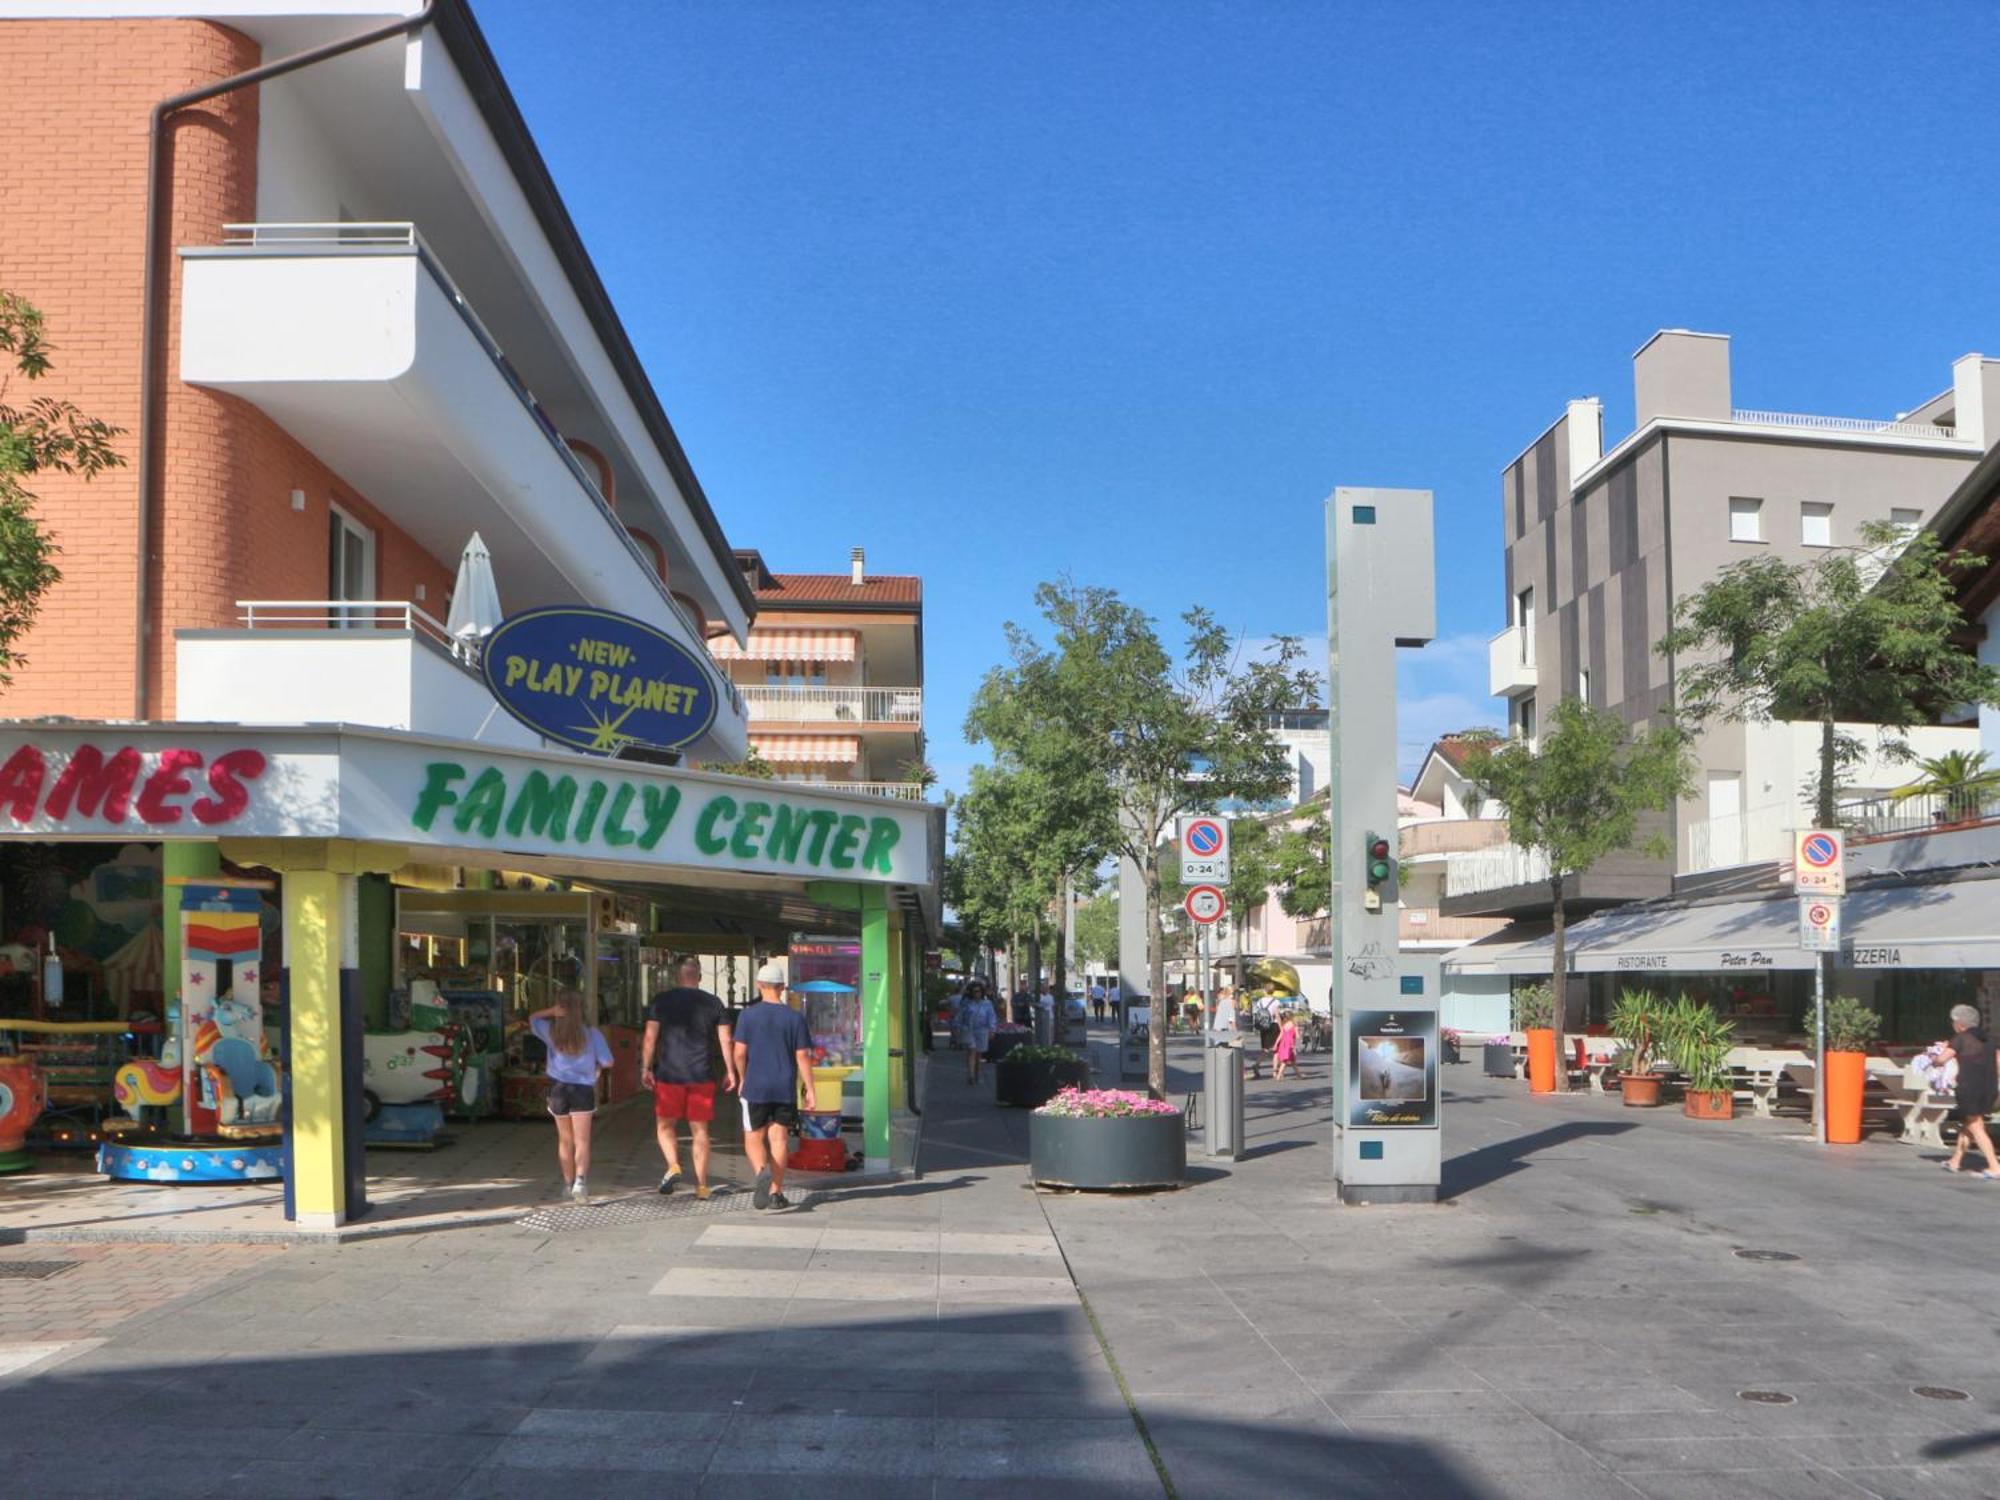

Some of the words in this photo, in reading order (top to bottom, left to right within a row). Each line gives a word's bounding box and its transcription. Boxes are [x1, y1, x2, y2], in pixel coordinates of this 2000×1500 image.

[505, 655, 583, 697] PLAY
[589, 670, 698, 716] PLANET
[411, 762, 681, 850] FAMILY
[694, 795, 901, 875] CENTER
[1618, 956, 1668, 968] RISTORANTE
[1720, 953, 1748, 967] Peter
[1750, 951, 1774, 966] Pan
[1842, 948, 1902, 965] PIZZERIA
